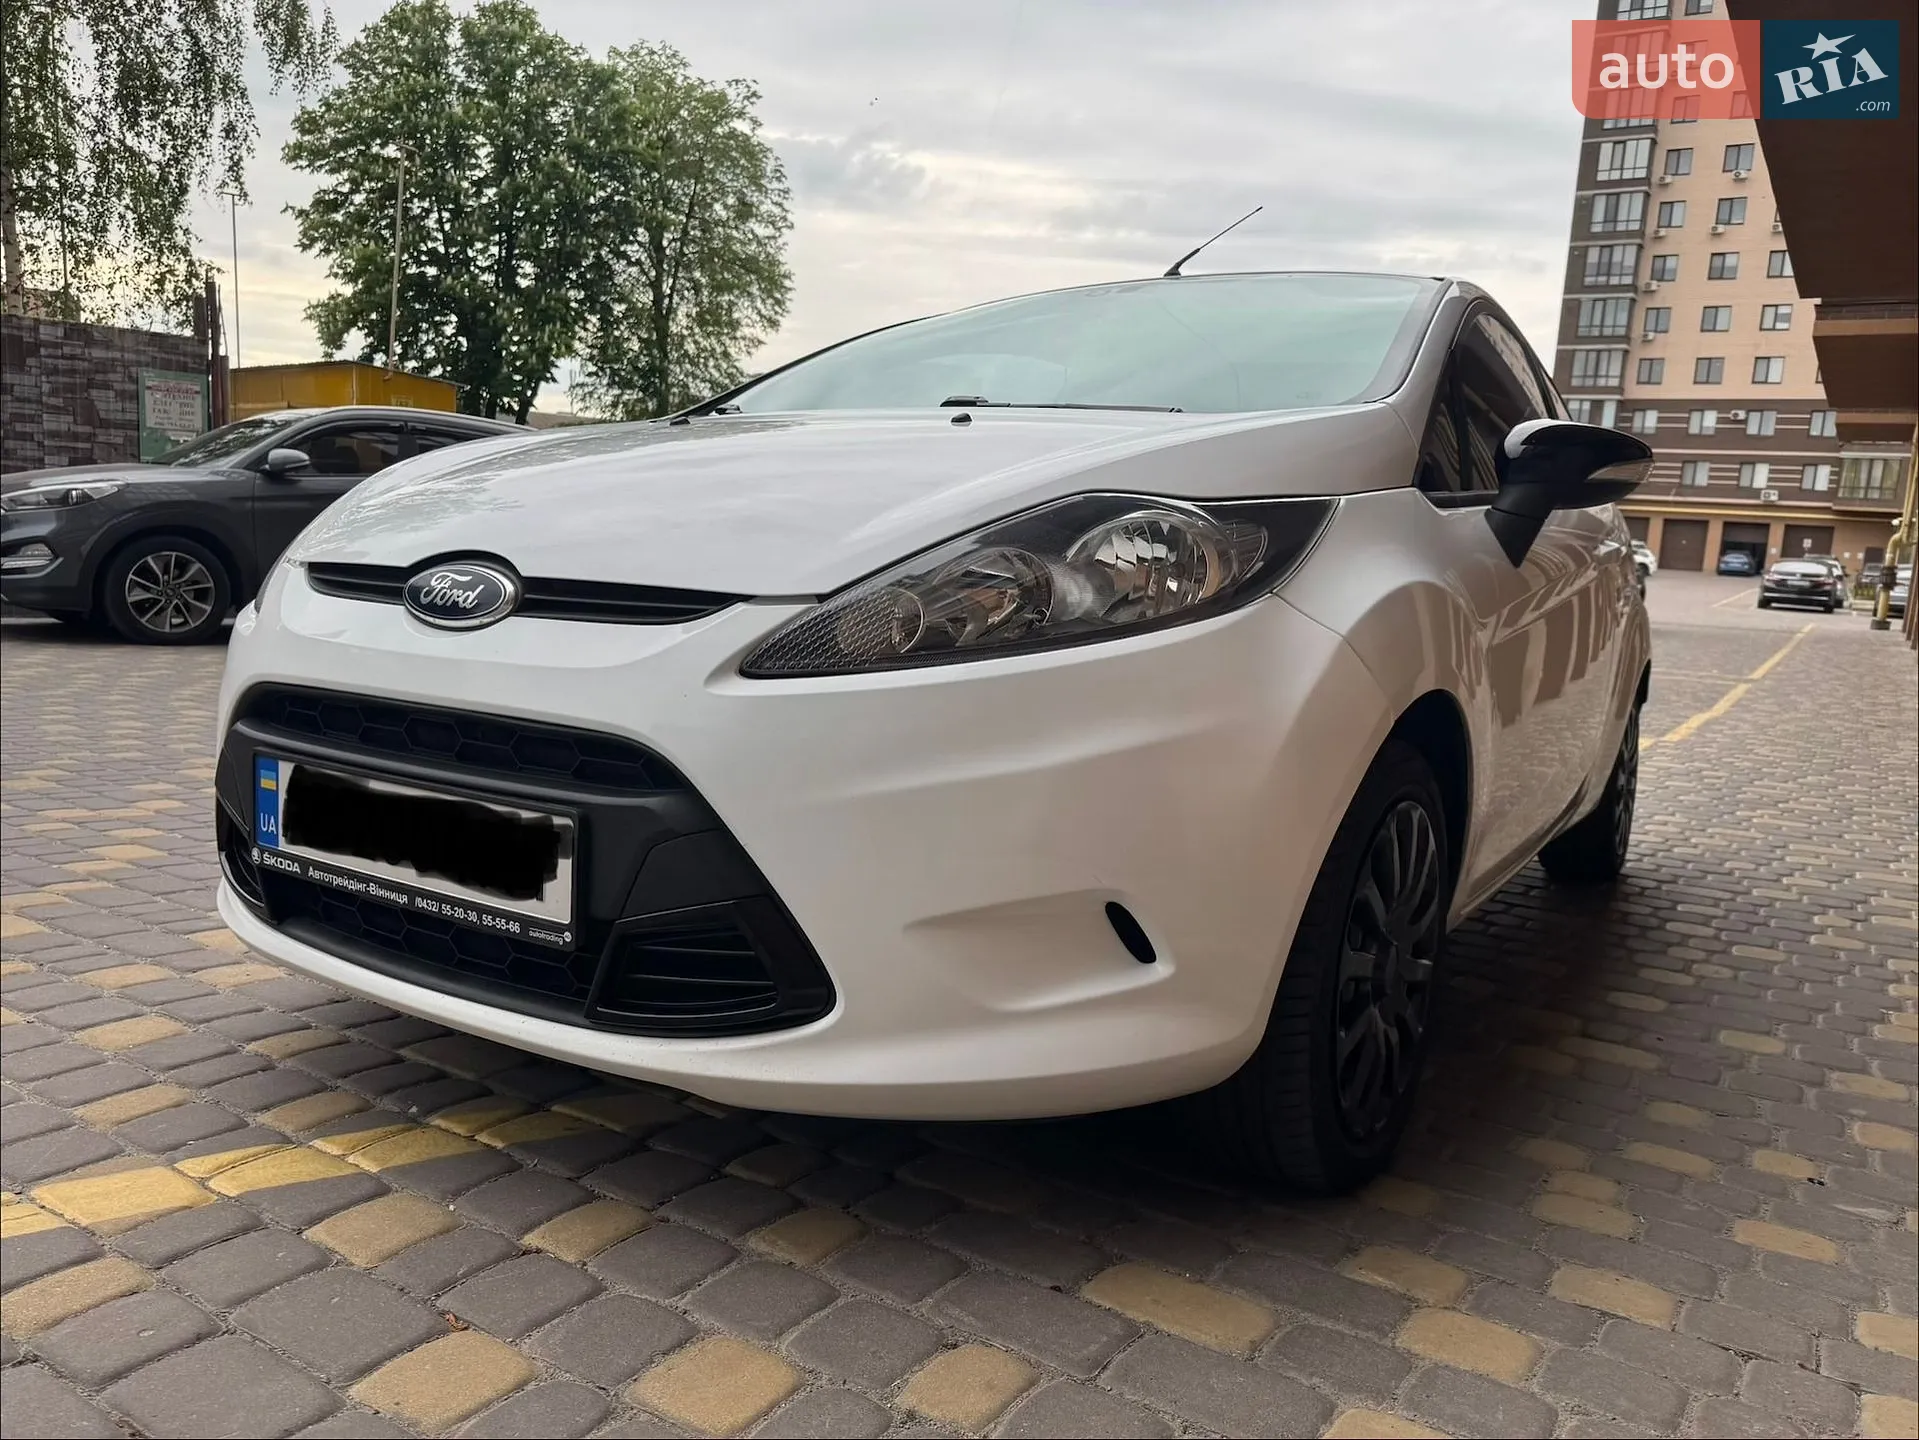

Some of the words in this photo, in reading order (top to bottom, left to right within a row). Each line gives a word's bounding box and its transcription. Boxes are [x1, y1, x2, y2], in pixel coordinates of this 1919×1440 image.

[420, 571, 485, 609] Ford
[259, 812, 278, 835] UA
[262, 851, 301, 874] ŠKODA
[307, 865, 409, 905] Автотрейдінг-Вінниця
[441, 903, 481, 926] 55-20-30,
[482, 914, 521, 934] 55-55-66
